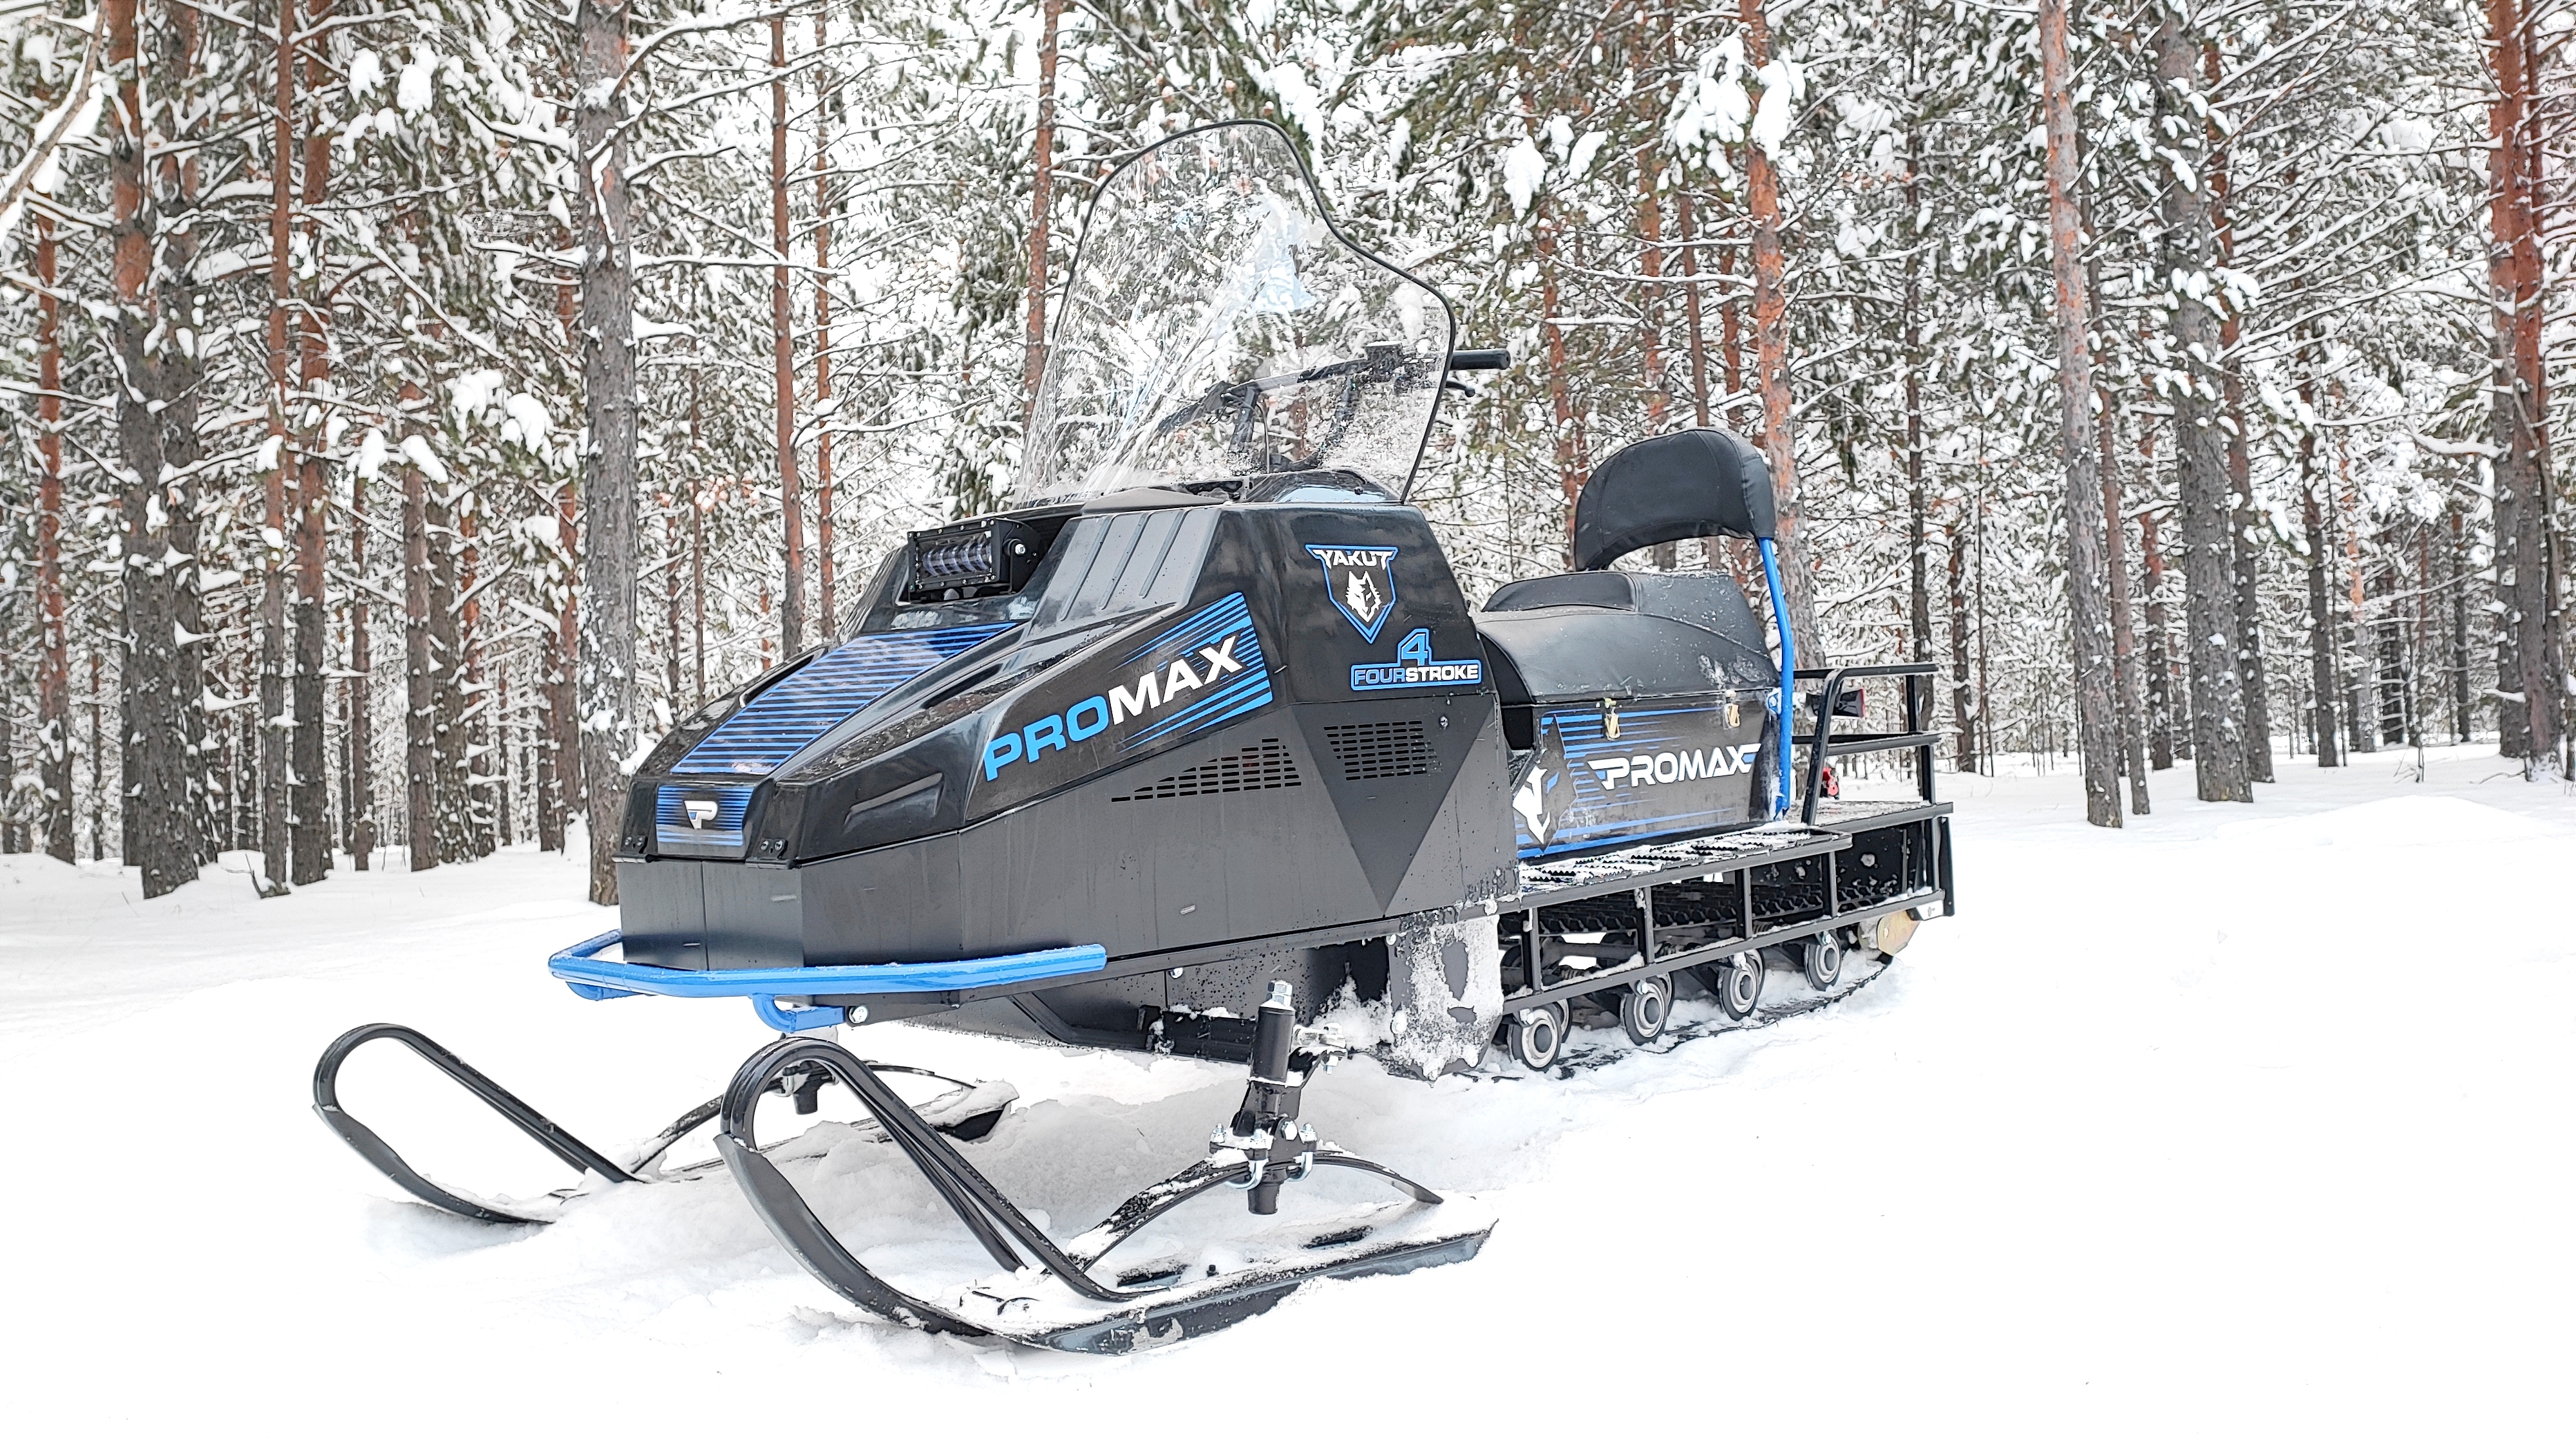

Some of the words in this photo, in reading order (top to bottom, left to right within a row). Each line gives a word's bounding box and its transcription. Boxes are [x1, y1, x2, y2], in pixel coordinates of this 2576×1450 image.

[1312, 549, 1394, 570] YAKUT
[1401, 634, 1428, 666] 4
[1354, 664, 1479, 685] FOURSTROKE
[983, 636, 1243, 782] PROMAX
[1587, 743, 1761, 790] PROMAX
